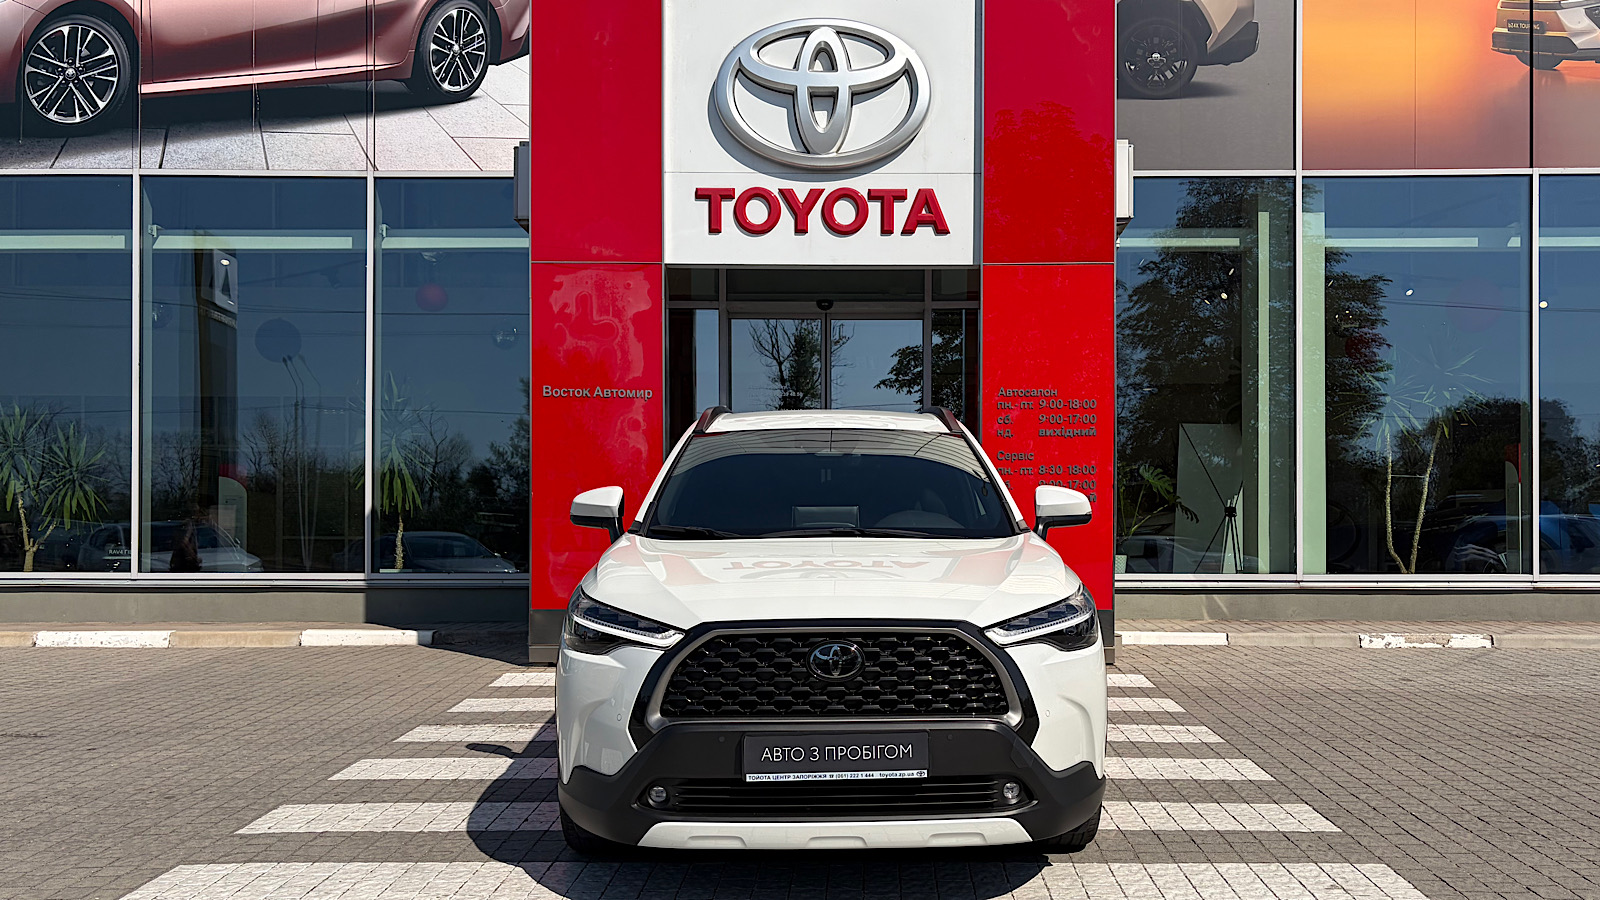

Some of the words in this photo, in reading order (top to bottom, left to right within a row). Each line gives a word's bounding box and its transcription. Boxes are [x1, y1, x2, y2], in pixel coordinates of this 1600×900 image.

[695, 186, 950, 236] TOYOTA
[542, 385, 591, 397] Восток
[593, 386, 653, 401] Автомир
[998, 387, 1058, 397] Автосалон
[1039, 399, 1097, 409] 9:00-18:00
[997, 414, 1014, 425] сб.
[1039, 414, 1097, 424] 9:00-17:00
[997, 429, 1014, 438] нд.
[1038, 426, 1097, 438] вихідний
[997, 450, 1034, 462] Сервіс
[1038, 465, 1097, 475] 8:30-18:00
[761, 746, 805, 762] АВТО
[825, 744, 913, 761] ПРОБІГОМ
